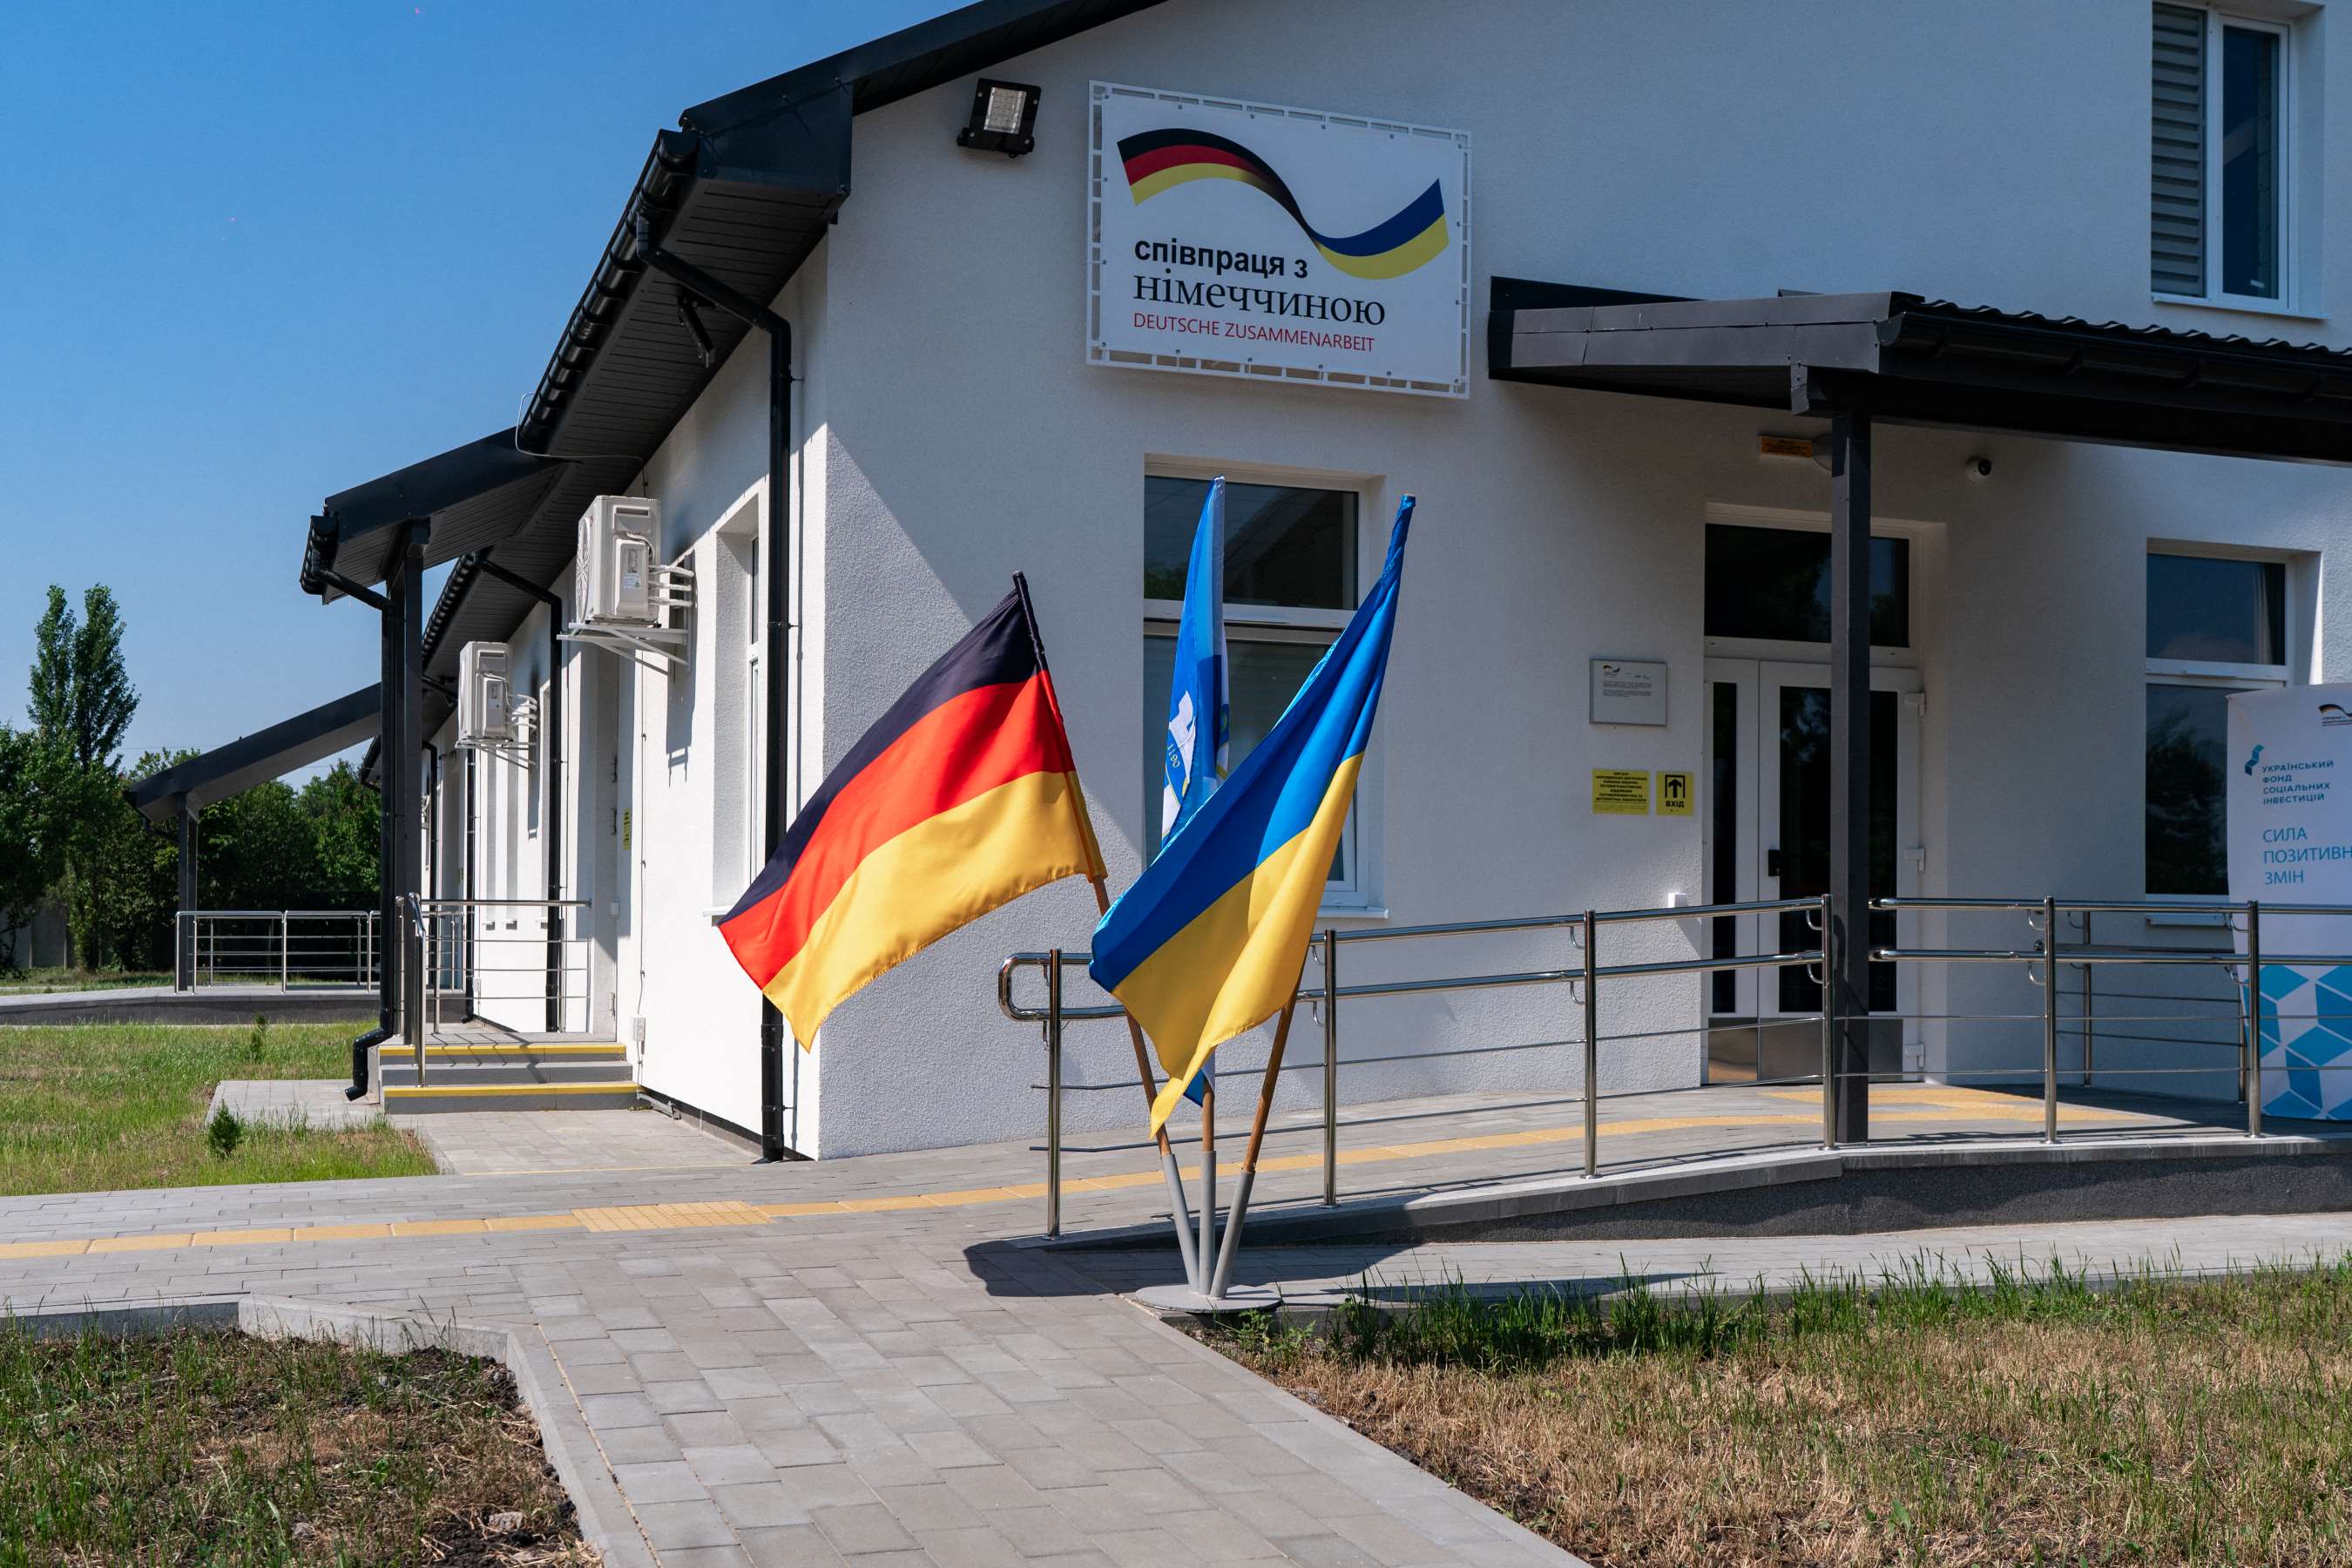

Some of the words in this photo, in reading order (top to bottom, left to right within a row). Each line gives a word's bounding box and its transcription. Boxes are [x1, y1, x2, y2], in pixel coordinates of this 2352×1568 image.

[1134, 239, 1285, 278] співпраця
[1294, 260, 1308, 278] з
[1134, 313, 1220, 336] DEUTSCHE
[1225, 322, 1375, 352] ZUSAMMENARBEIT
[2262, 760, 2334, 774] УКРАЇНСЬКИЙ
[2263, 774, 2292, 783] ФОНД
[2263, 782, 2331, 794] СОЦІАЛЬНИХ
[2263, 794, 2325, 805] ІНВЕСТИЦІЙ
[2263, 828, 2308, 843] СИЛА
[2265, 871, 2304, 885] ЗМІН
